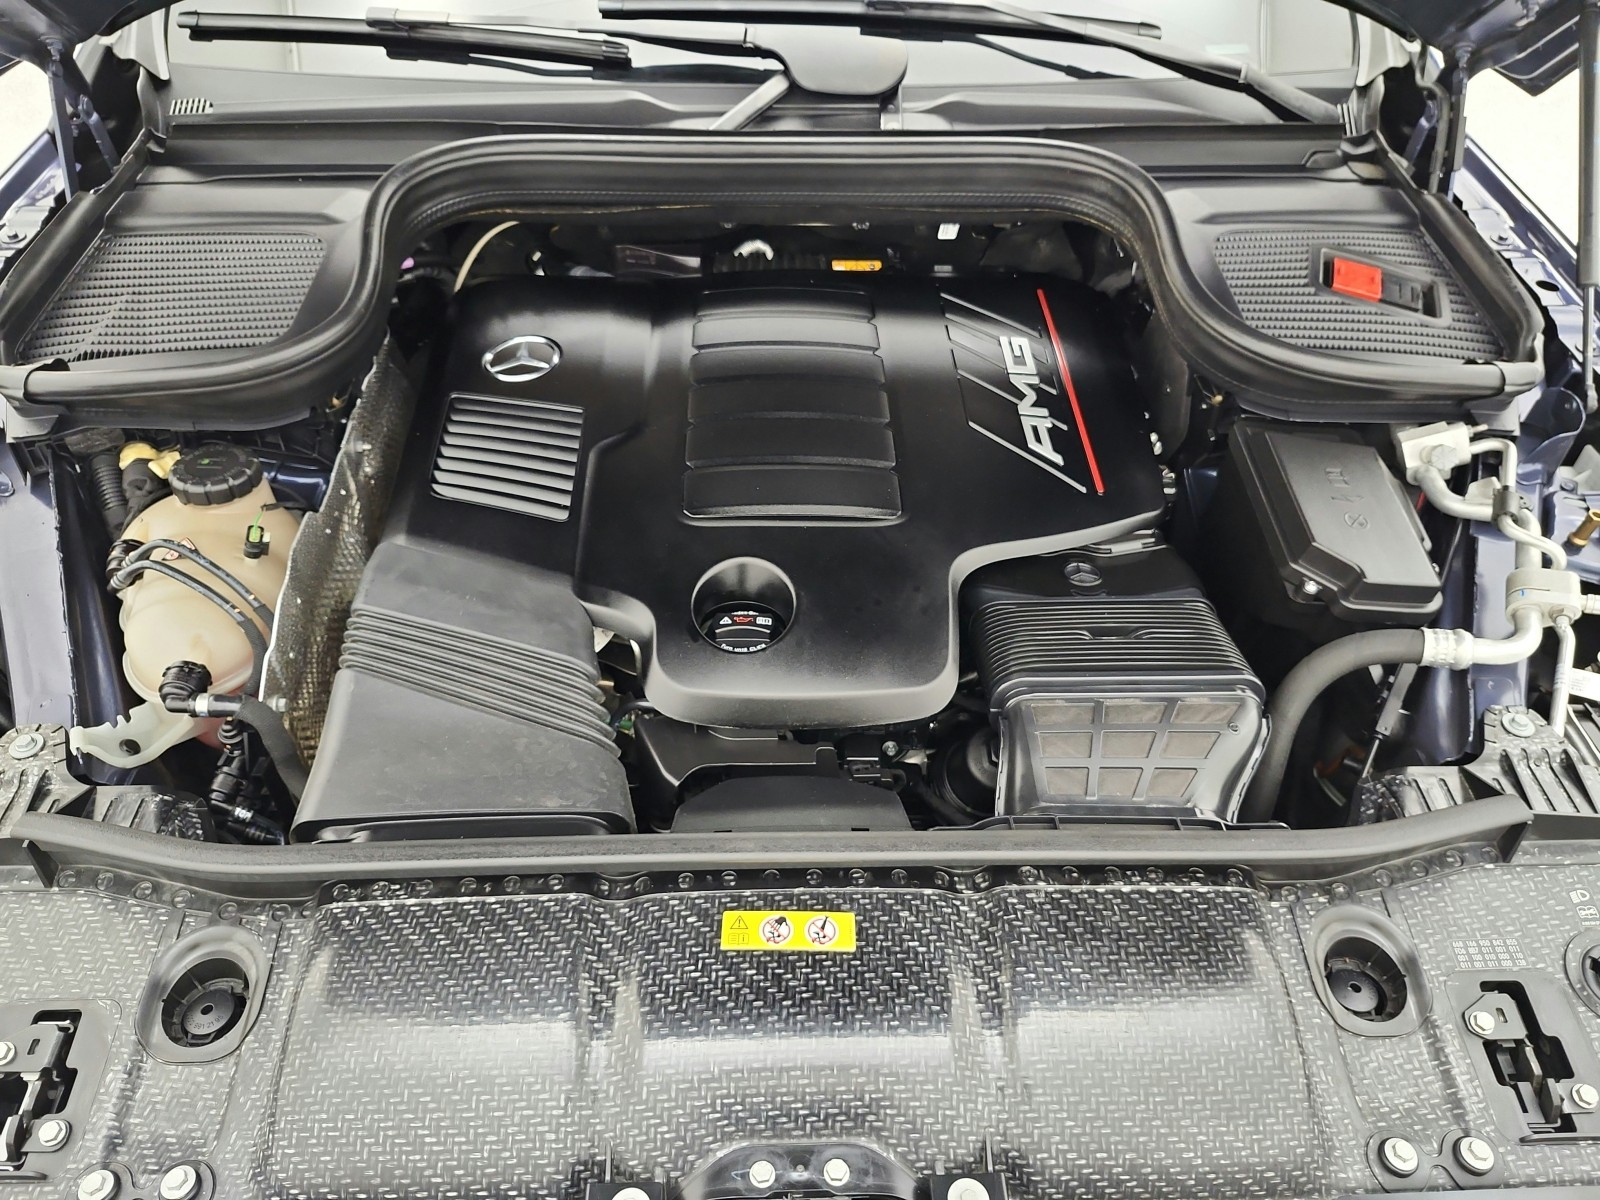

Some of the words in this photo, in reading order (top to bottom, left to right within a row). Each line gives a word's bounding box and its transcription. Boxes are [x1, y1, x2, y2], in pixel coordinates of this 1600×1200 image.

[1000, 336, 1064, 467] AMG
[1481, 946, 1493, 954] 011
[1460, 961, 1472, 969] 011
